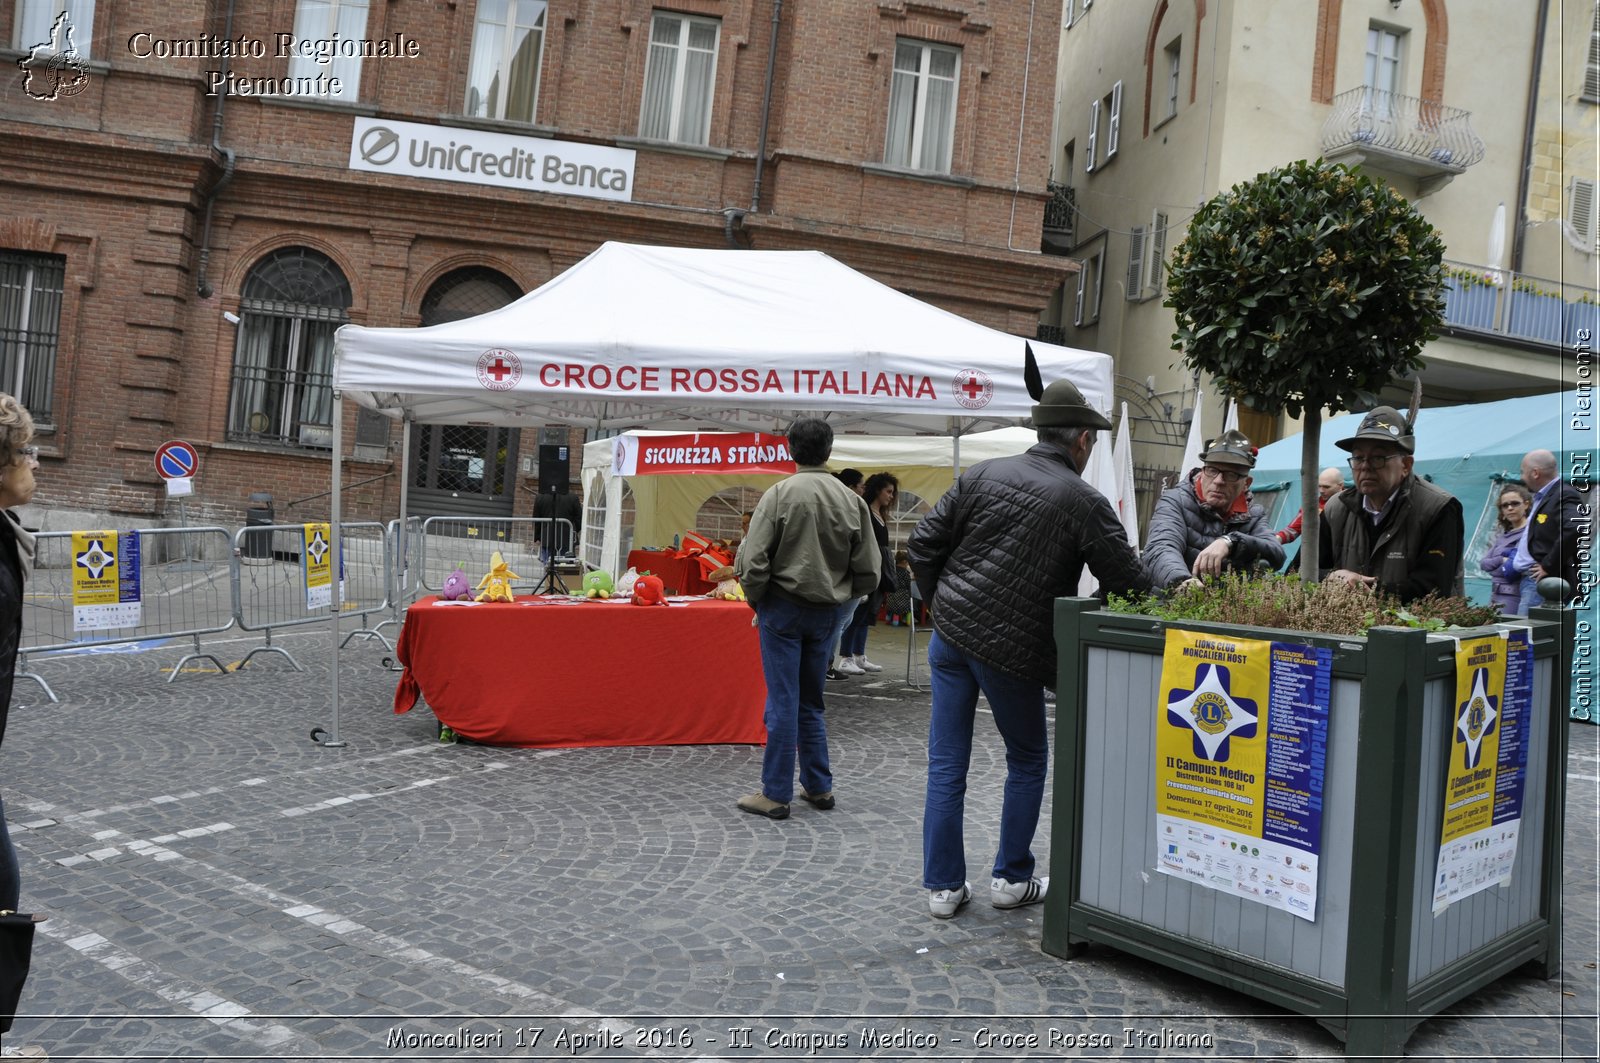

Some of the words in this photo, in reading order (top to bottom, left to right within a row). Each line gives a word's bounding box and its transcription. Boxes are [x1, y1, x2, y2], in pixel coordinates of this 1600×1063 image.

[408, 138, 535, 181] UniCredit
[541, 154, 628, 192] Banca
[539, 363, 660, 391] CROCE
[670, 367, 784, 393] ROSSA
[793, 369, 937, 400] ITALIANA
[307, 428, 329, 436] POSTA
[1195, 639, 1215, 650] LIONS
[1216, 642, 1236, 653] CLUB
[1182, 647, 1225, 662] MONCALIERI
[1226, 654, 1247, 664] HOST
[1200, 693, 1224, 705] LIONS
[1206, 705, 1217, 720] L
[1166, 756, 1174, 768] II
[1176, 758, 1217, 775] Campus
[1219, 765, 1255, 784] Medico
[1176, 771, 1204, 782] Distretto
[1205, 776, 1222, 786] Lions
[1223, 780, 1234, 789] 108
[1166, 779, 1202, 793] Prevenzione
[1202, 786, 1230, 799] Sanitaria
[1230, 793, 1254, 805] Gratuita
[1166, 792, 1202, 806] Domenica
[1204, 800, 1212, 808] 17
[1213, 802, 1235, 814] aprile
[1236, 808, 1253, 818] 2016
[1163, 854, 1184, 864] AVIVA
